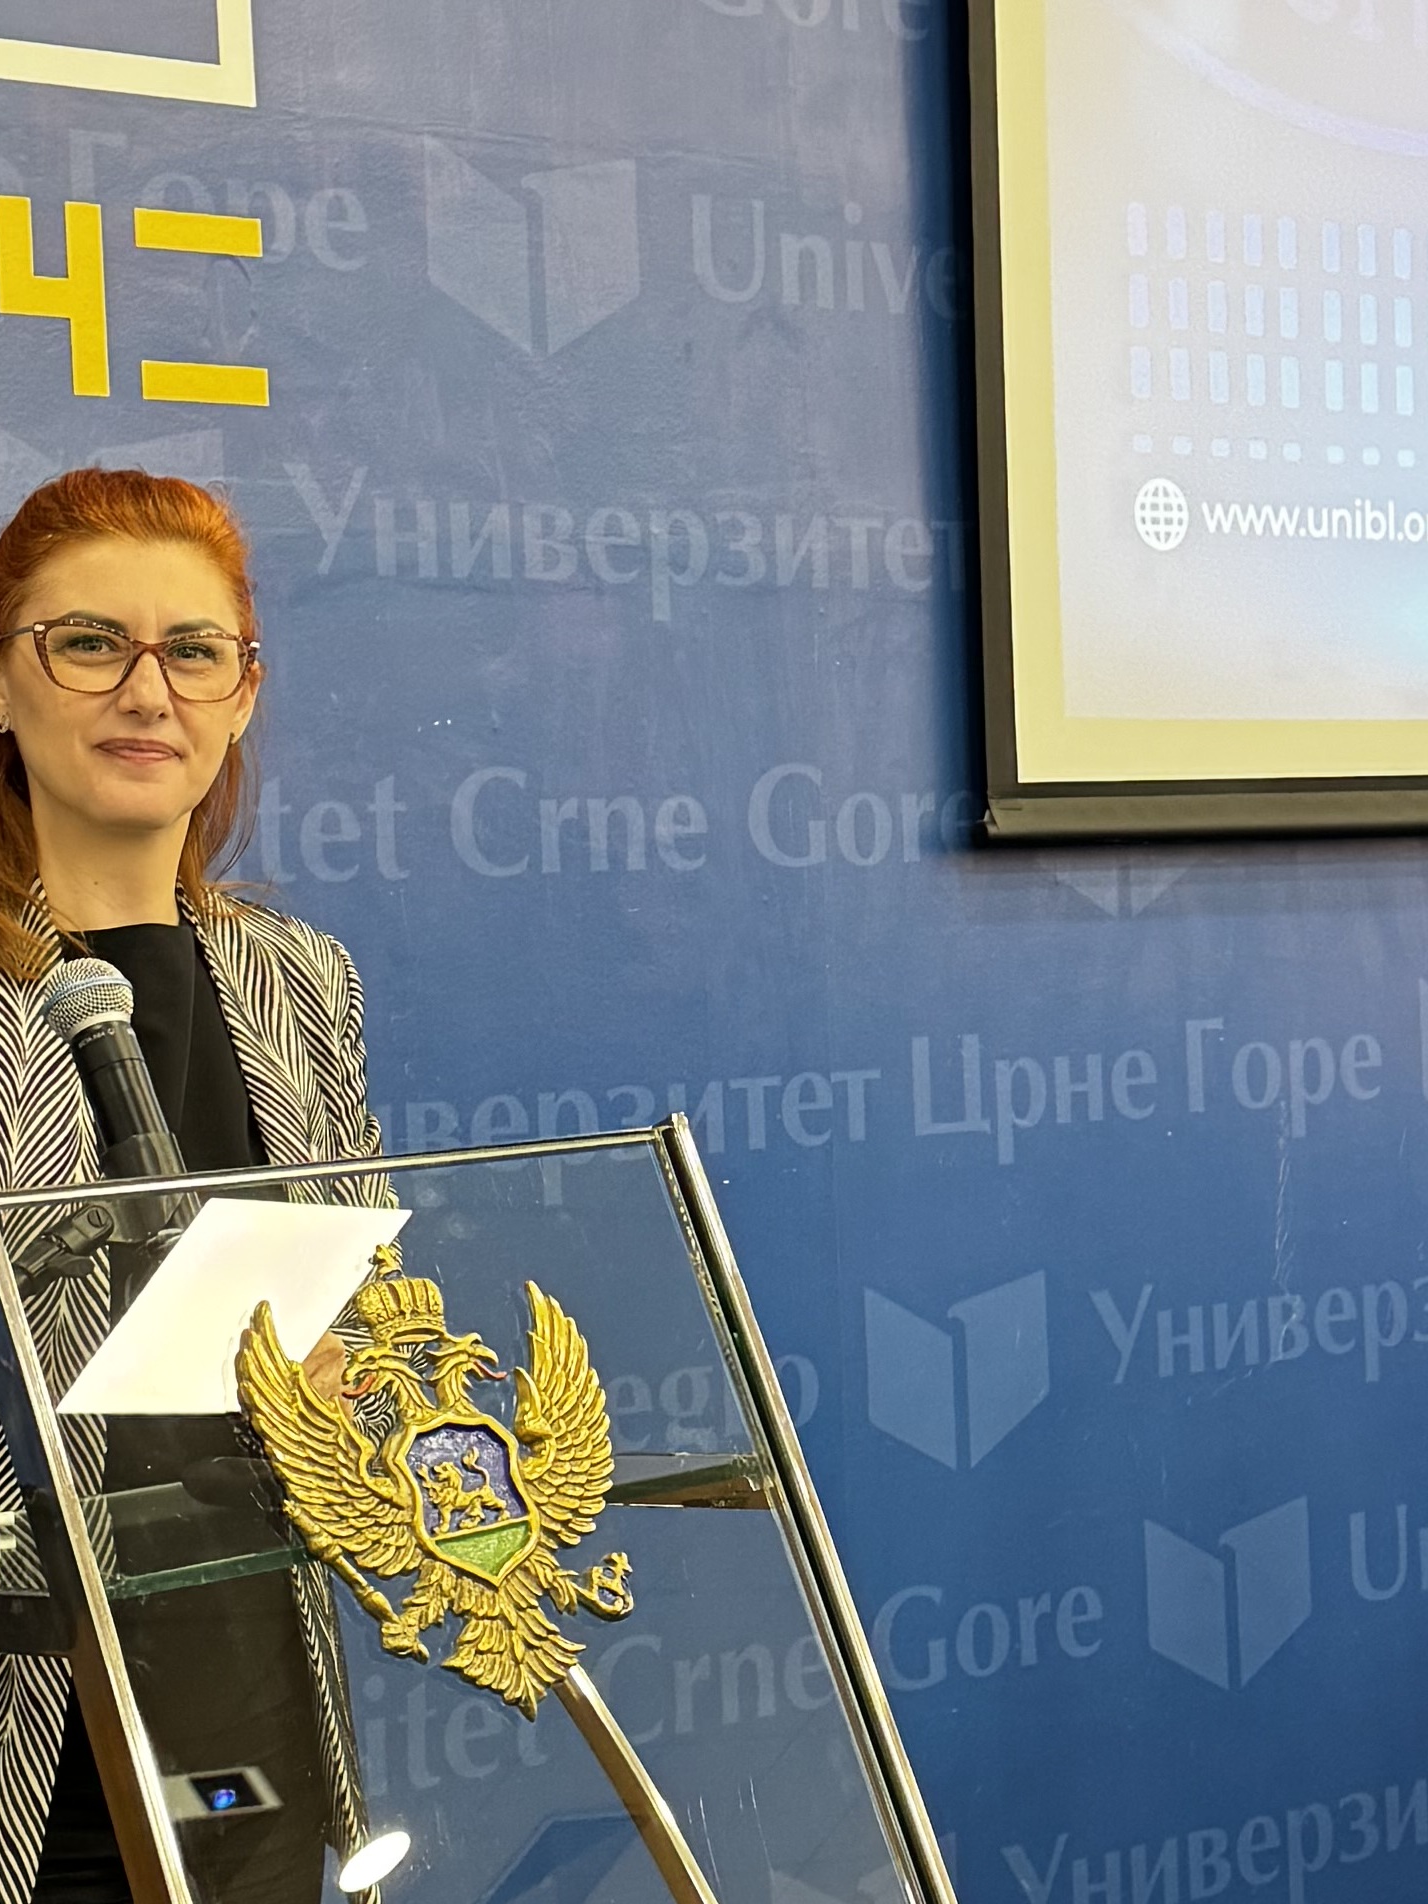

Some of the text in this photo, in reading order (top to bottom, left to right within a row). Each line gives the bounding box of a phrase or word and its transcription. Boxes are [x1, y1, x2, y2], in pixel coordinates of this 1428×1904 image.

[449, 765, 709, 881] Crne
[913, 1033, 1159, 1165] Црне
[1185, 1017, 1384, 1138] Горе
[873, 1581, 1104, 1693] Gore
